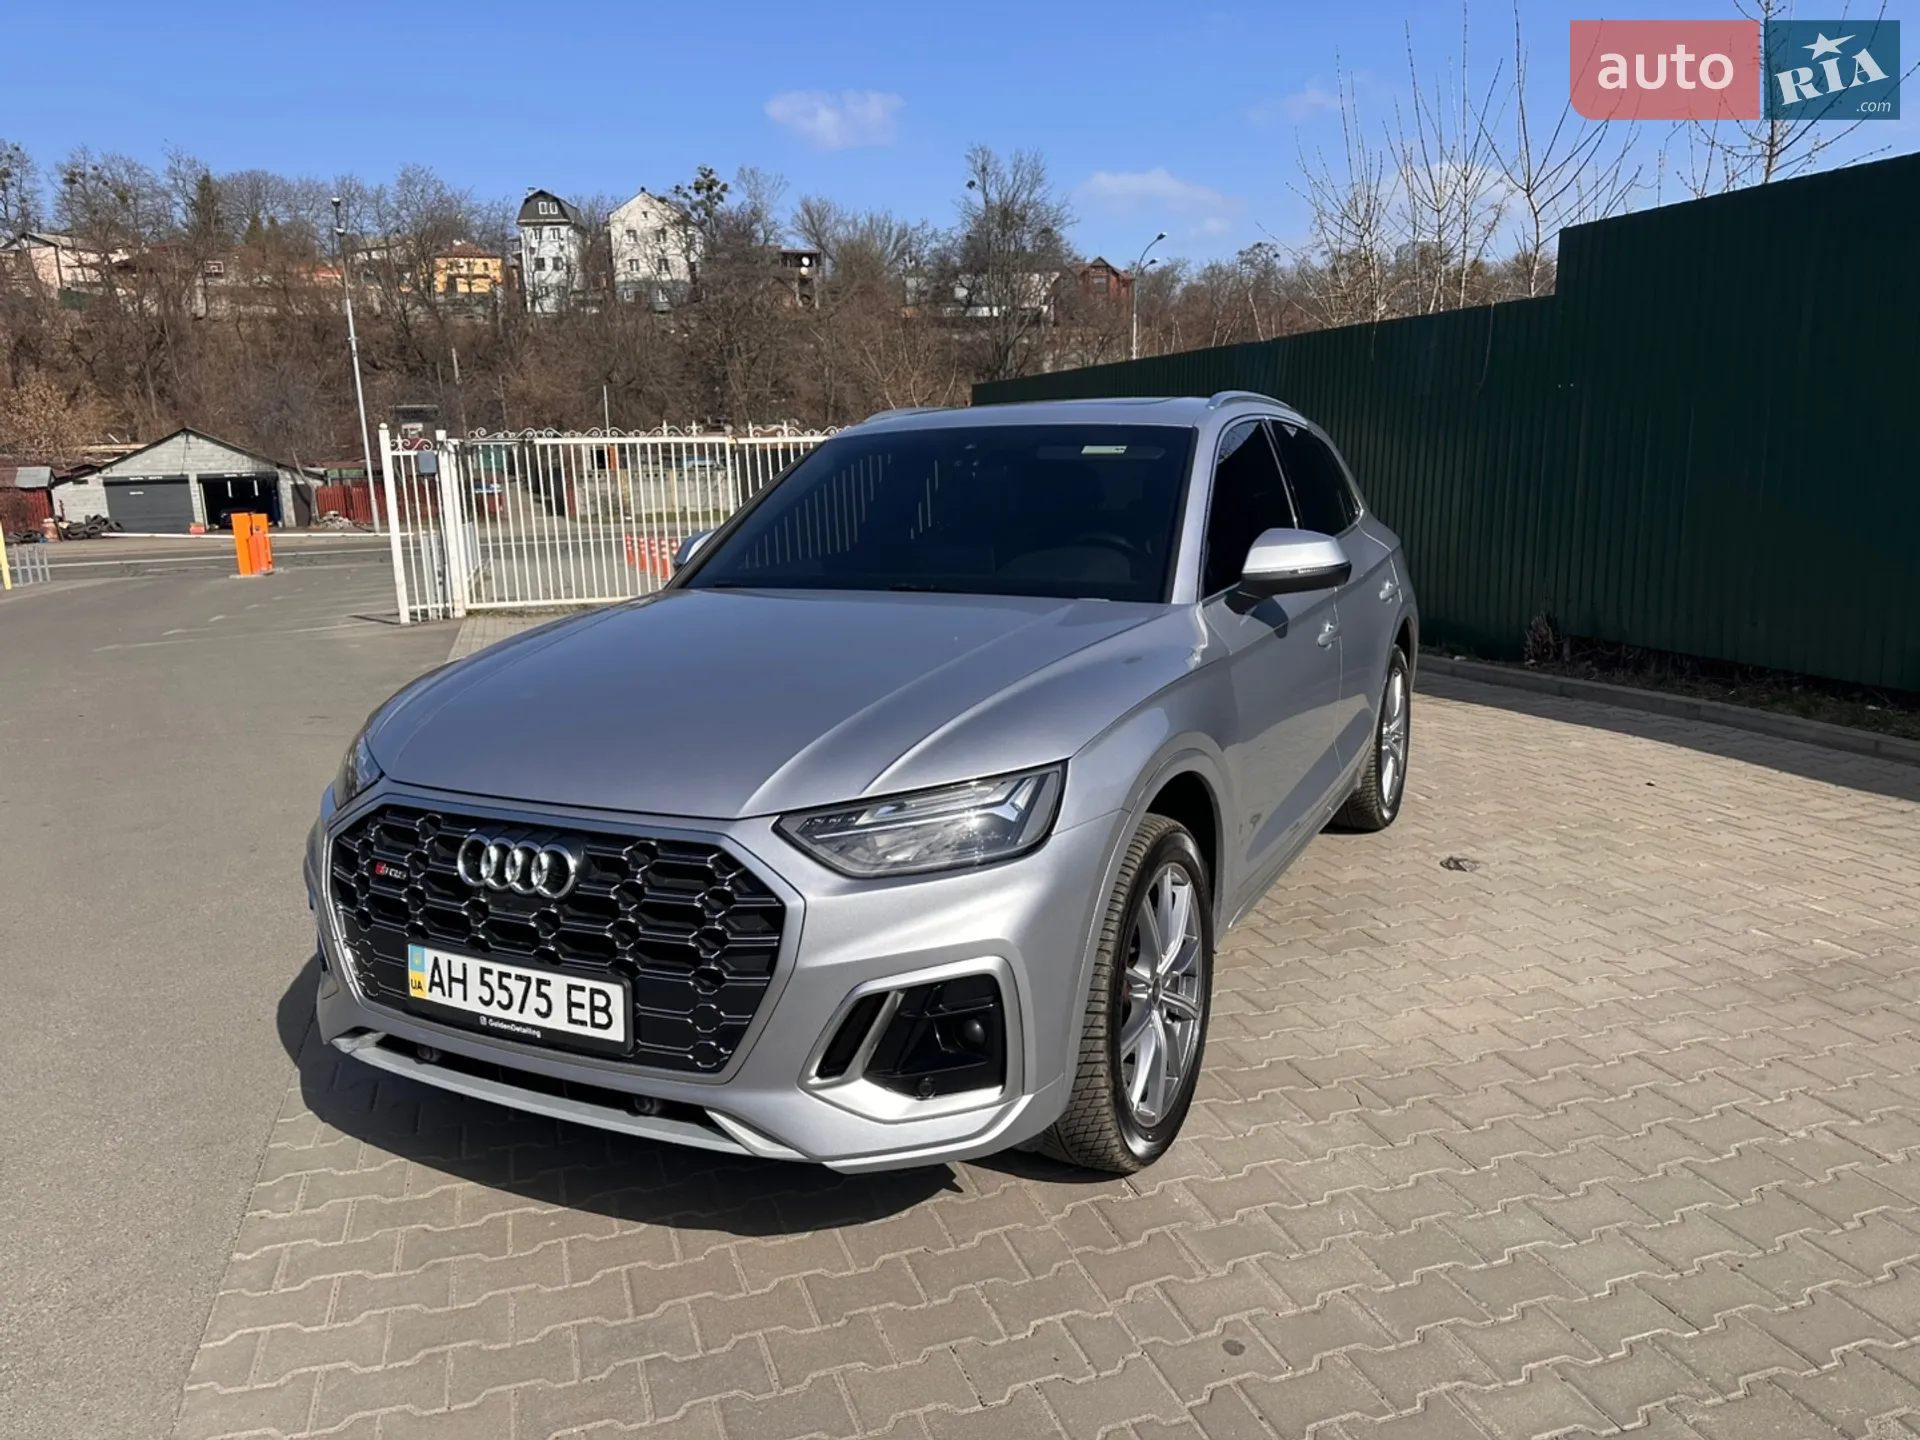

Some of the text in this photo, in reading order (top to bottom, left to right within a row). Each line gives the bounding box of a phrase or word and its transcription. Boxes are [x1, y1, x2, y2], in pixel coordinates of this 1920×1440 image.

[410, 979, 424, 991] UA
[428, 956, 614, 1031] AH 5575 EB
